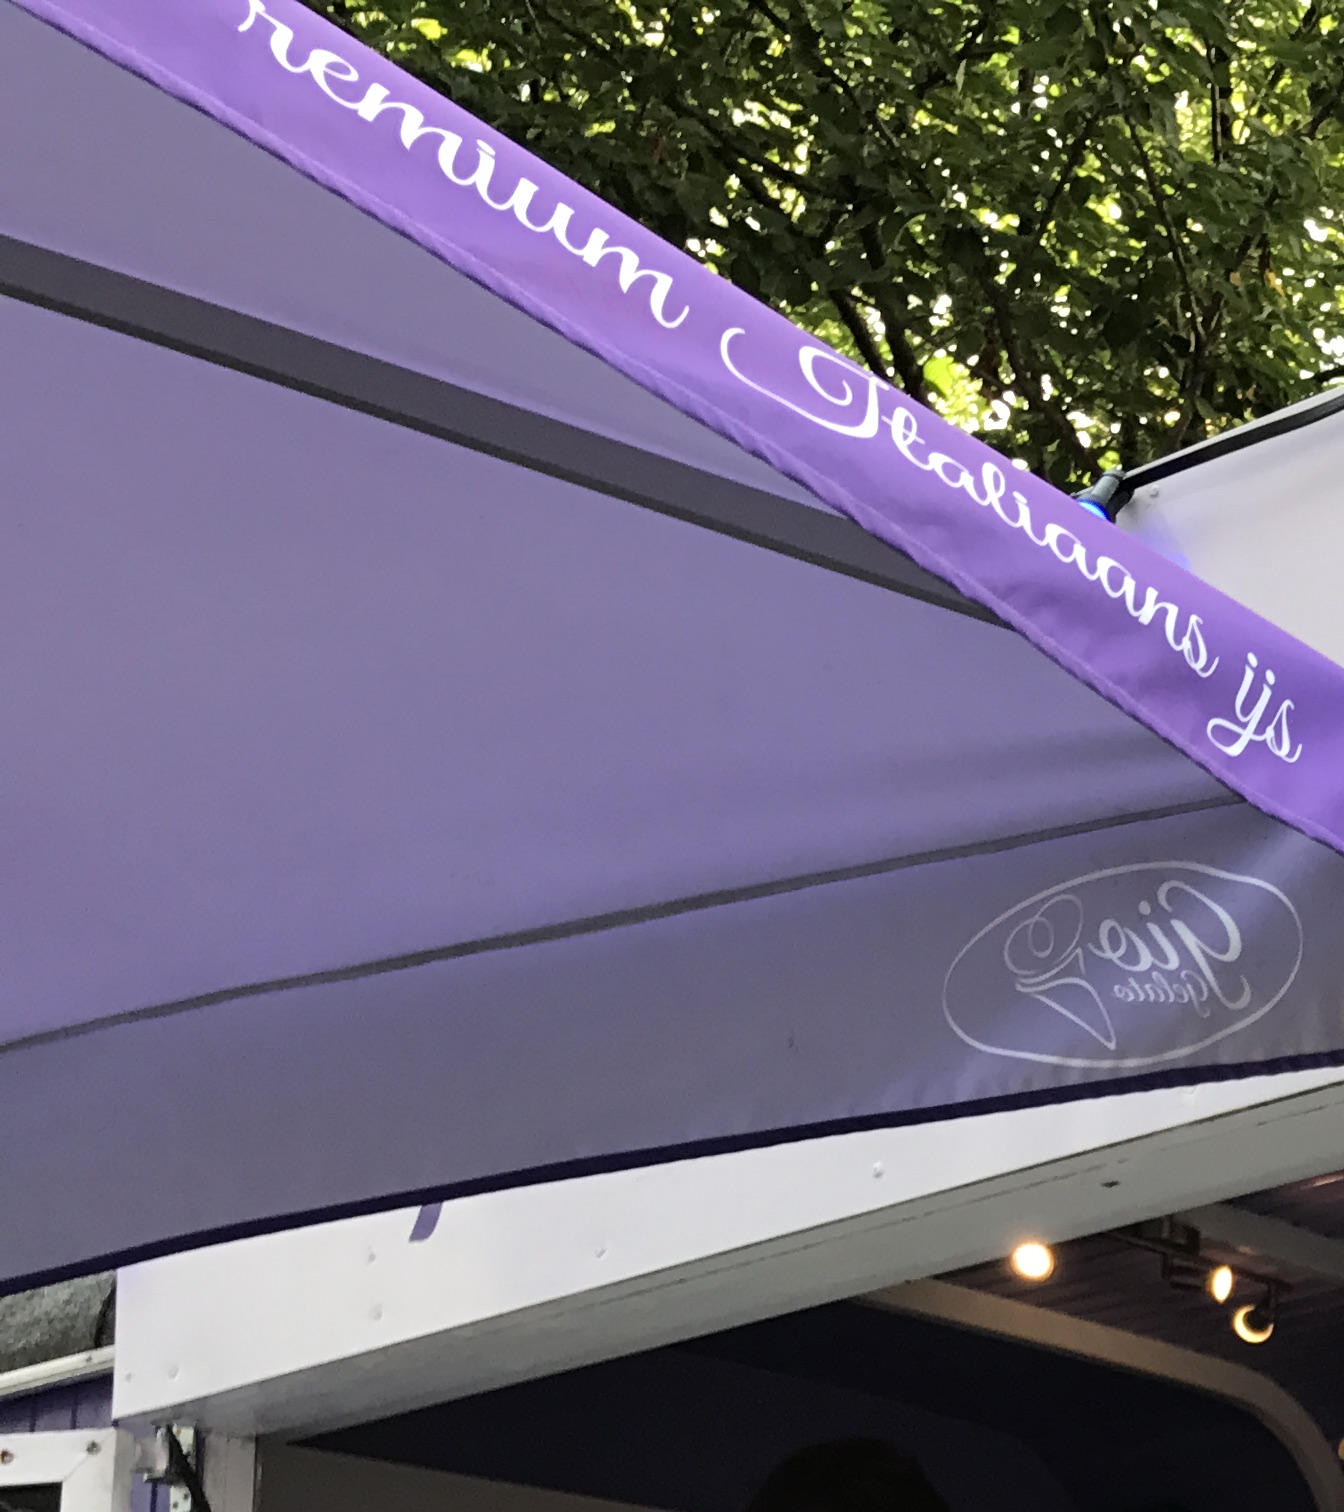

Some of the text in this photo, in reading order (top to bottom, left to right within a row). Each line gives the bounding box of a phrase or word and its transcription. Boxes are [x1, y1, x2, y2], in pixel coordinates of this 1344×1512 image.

[237, 0, 1303, 763] remium Italiaans ijs
